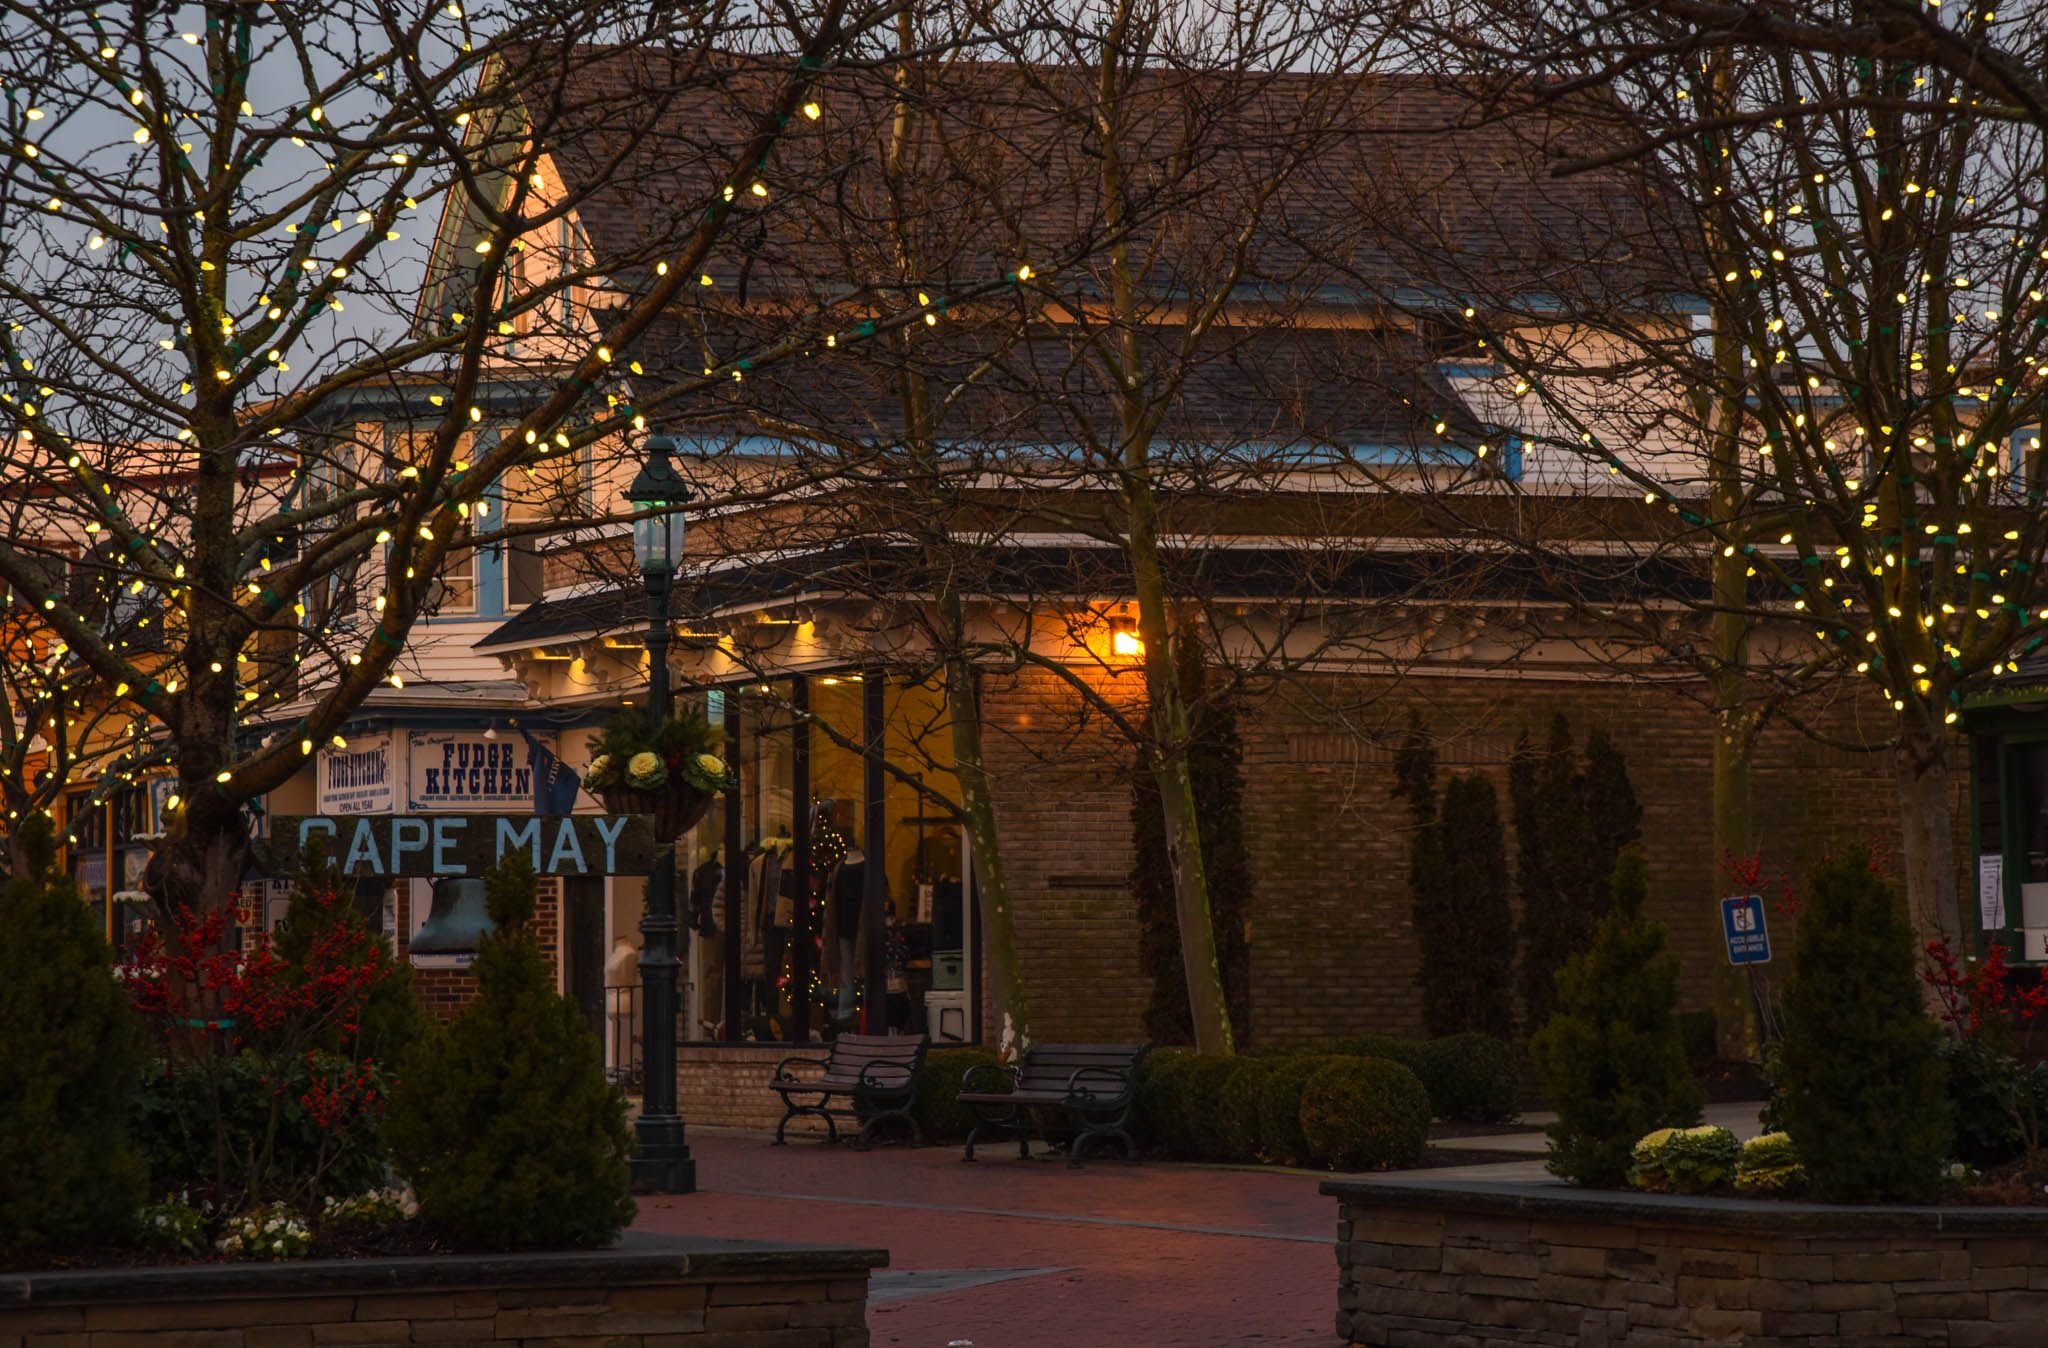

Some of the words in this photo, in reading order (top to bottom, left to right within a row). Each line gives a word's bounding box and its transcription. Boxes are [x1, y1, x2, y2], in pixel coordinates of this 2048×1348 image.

[443, 743, 513, 768] FUDGE
[426, 768, 530, 794] KITCHEN
[339, 802, 352, 813] OPEN
[352, 801, 361, 811] ALL
[361, 800, 373, 810] YEAR
[298, 817, 468, 875] CAPE
[496, 817, 629, 874] MAY
